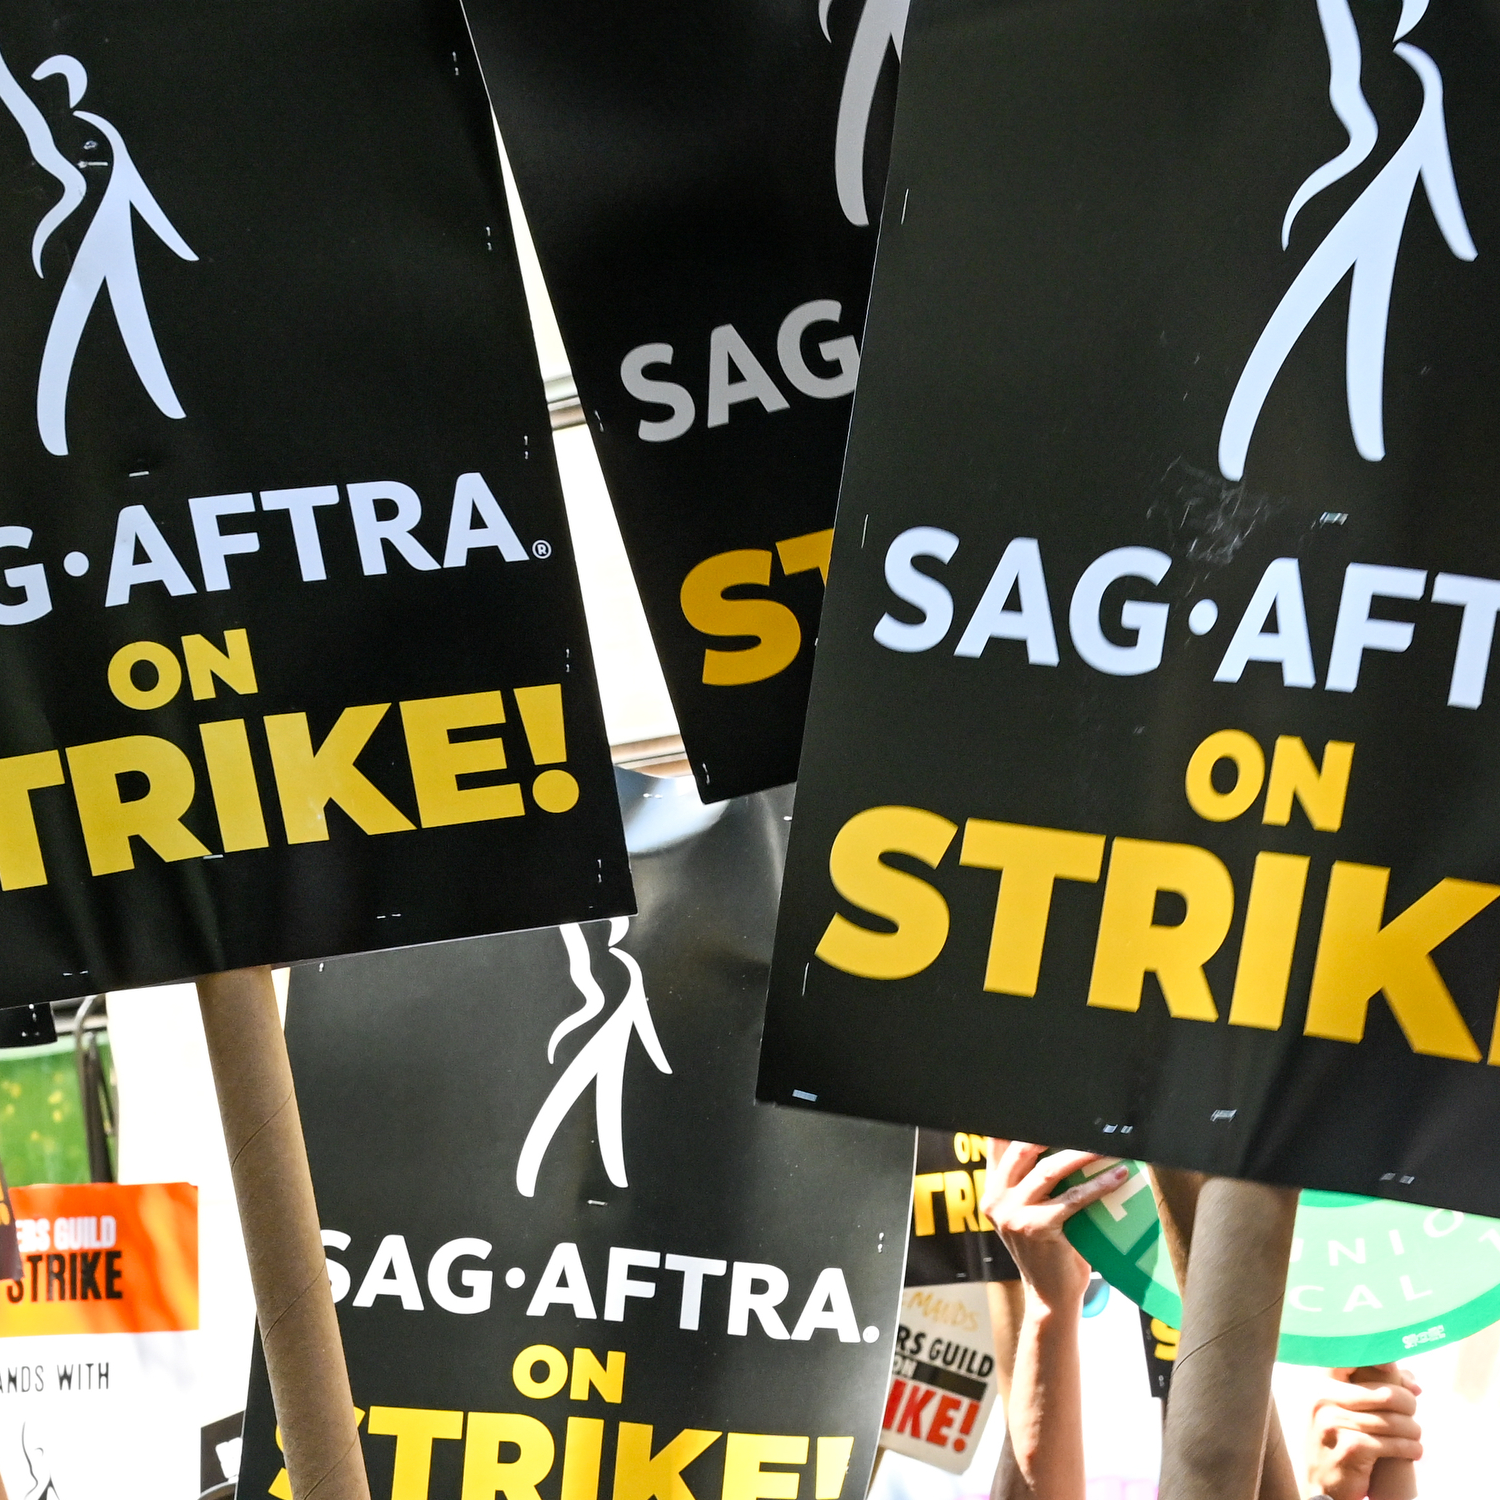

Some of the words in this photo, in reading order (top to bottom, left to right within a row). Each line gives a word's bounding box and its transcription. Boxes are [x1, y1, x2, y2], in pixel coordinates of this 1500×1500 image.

[108, 629, 258, 710] ON
[1185, 729, 1355, 833] ON
[53, 1215, 116, 1250] GUILD
[56, 1362, 109, 1391] WITH
[512, 1344, 626, 1404] ON
[928, 1338, 996, 1378] GUILD
